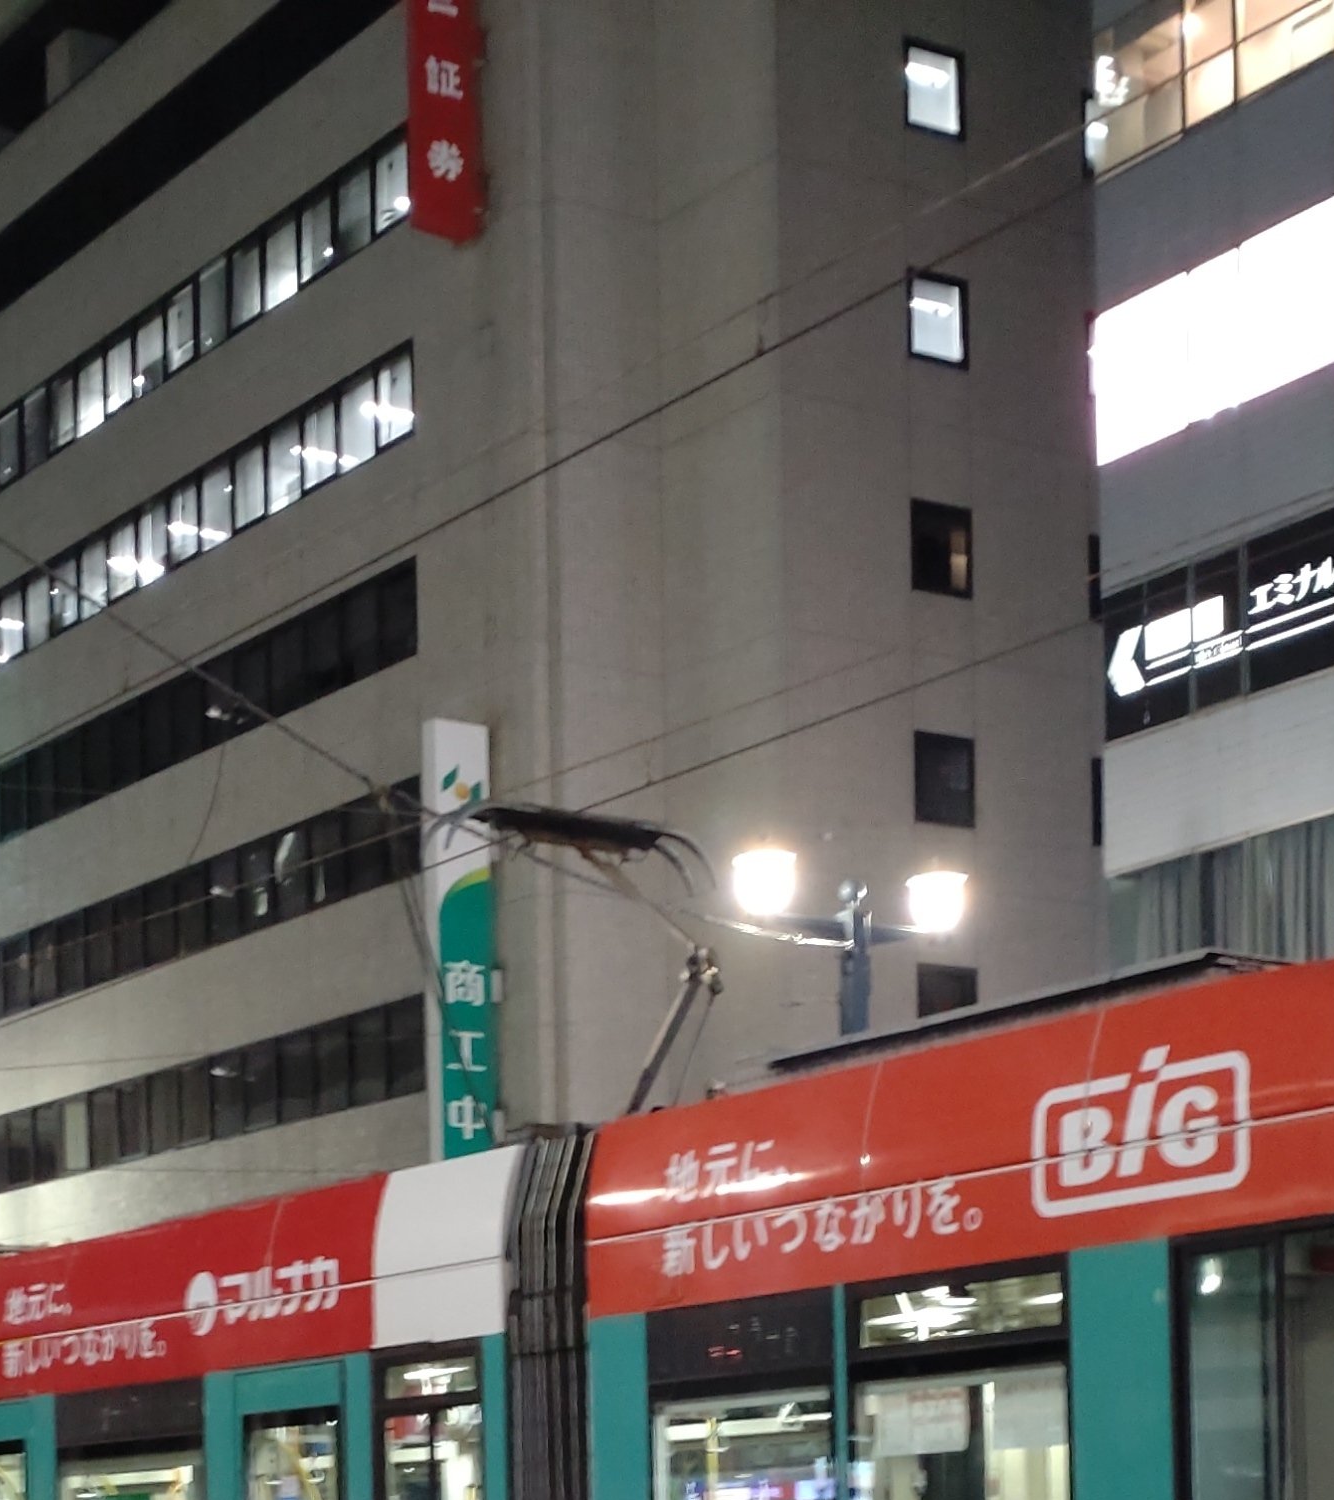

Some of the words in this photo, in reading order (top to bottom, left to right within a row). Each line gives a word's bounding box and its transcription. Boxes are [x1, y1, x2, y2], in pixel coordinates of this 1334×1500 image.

[661, 1178, 983, 1277] 新しいつながりを。
[218, 1254, 340, 1326] マルナカ
